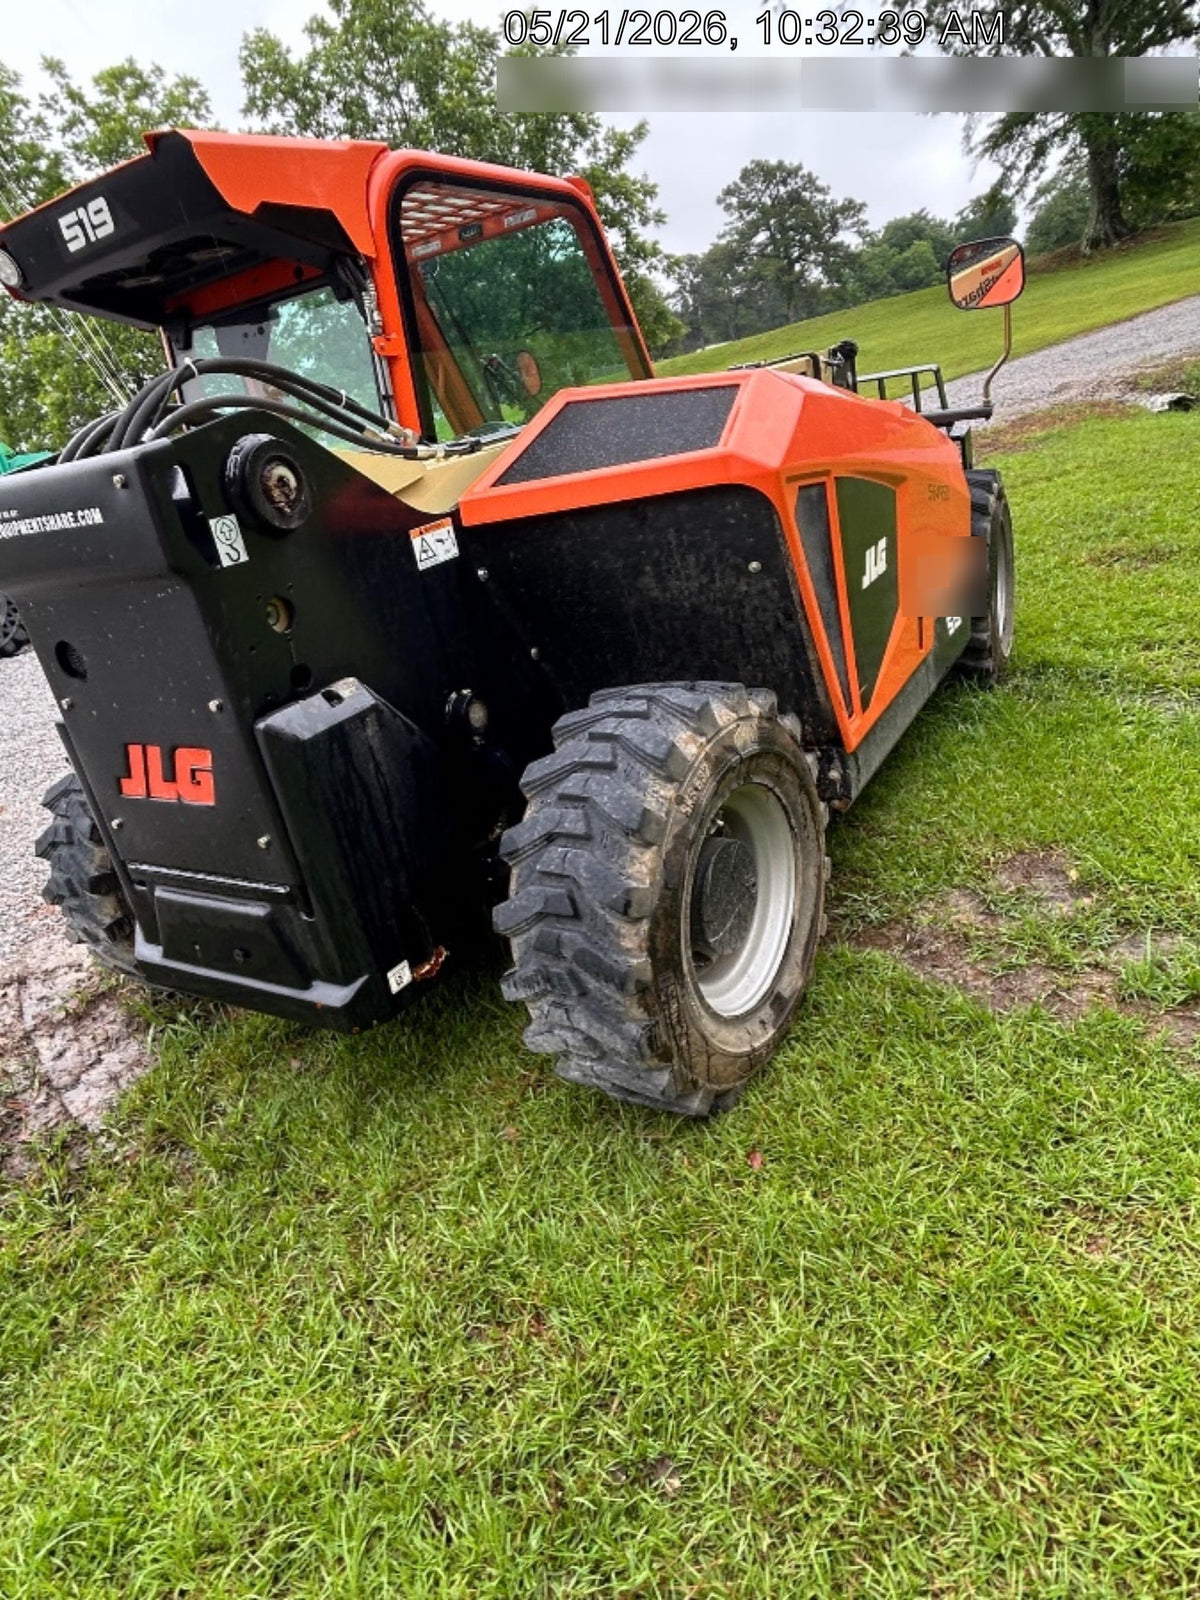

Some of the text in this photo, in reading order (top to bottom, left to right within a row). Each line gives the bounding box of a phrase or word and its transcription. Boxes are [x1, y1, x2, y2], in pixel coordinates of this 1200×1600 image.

[58, 196, 115, 253] 519
[861, 536, 888, 590] JLG
[119, 743, 216, 807] JLG
